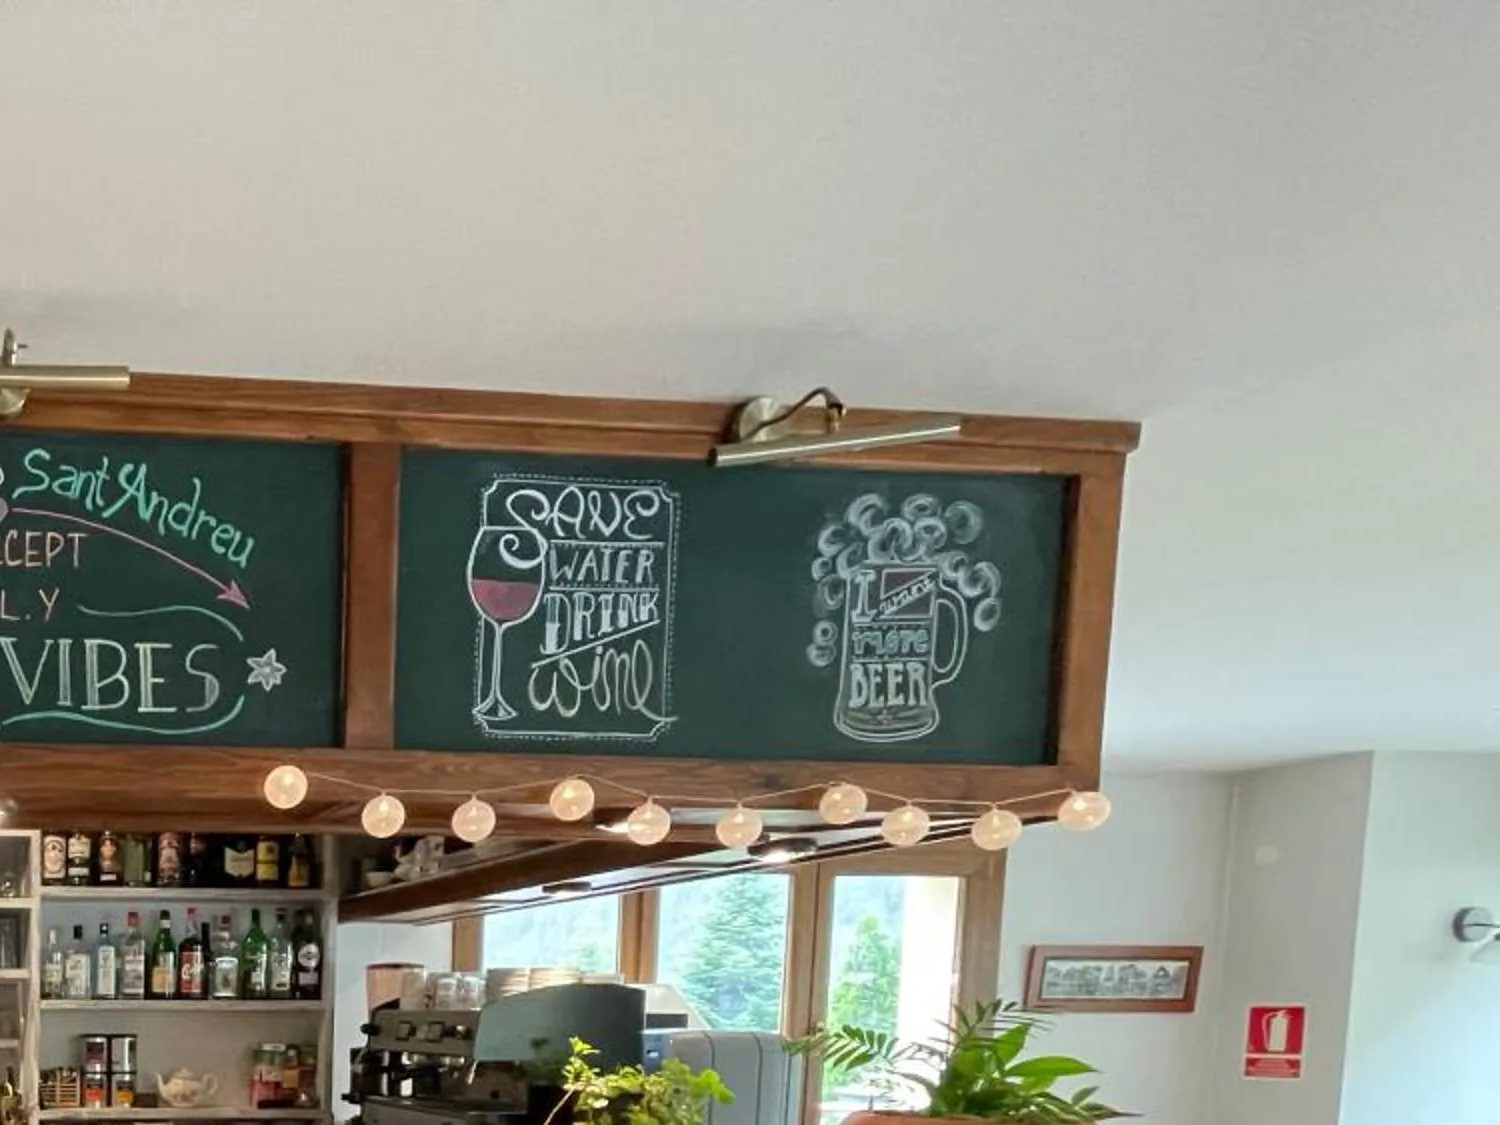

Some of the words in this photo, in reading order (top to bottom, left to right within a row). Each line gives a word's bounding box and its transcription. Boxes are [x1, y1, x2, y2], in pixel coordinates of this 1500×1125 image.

[499, 485, 660, 570] SAVE
[550, 548, 656, 584] WATER
[540, 590, 660, 655] DRINK
[848, 662, 928, 708] BEER
